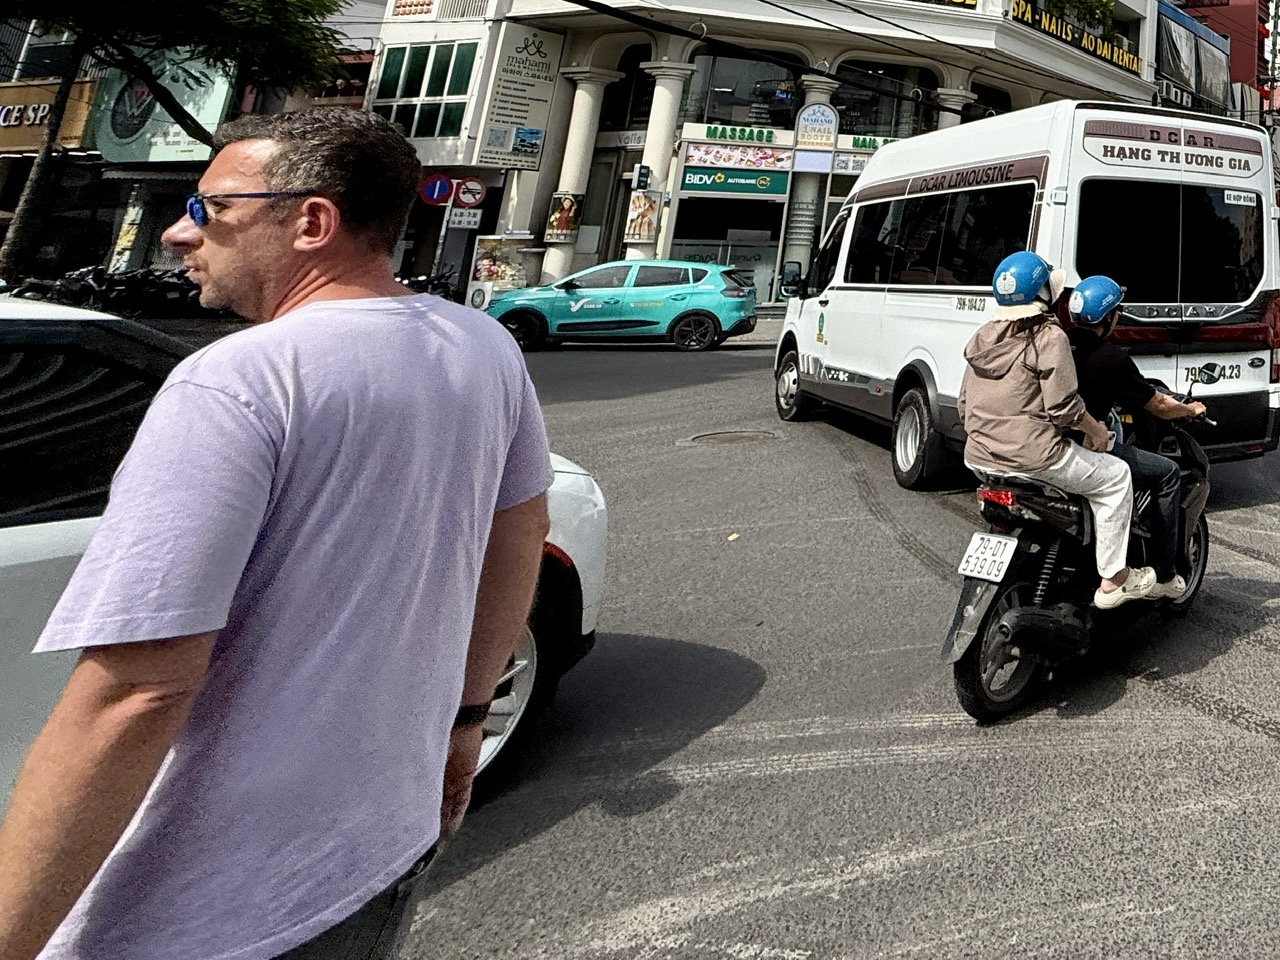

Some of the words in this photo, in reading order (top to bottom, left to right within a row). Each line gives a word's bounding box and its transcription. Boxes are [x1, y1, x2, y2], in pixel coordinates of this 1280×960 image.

[1041, 11, 1073, 42] NAILS
[1081, 31, 1095, 52] AO
[1096, 38, 1112, 61] DAI
[1112, 45, 1143, 74] RENTAL
[507, 55, 551, 71] mahami
[0, 104, 23, 127] CE
[23, 103, 52, 126] SP
[706, 126, 775, 143] MASSAGE
[852, 136, 878, 149] NAIL
[1149, 129, 1214, 148] DCAR
[1103, 145, 1152, 161] HẠNG
[1228, 158, 1251, 171] GIA
[685, 173, 715, 185] BIDV
[727, 177, 757, 185] AUTOBANK
[920, 175, 947, 192] DCAR
[948, 163, 1015, 188] LIMOUSINE
[1146, 305, 1216, 317] DCAR
